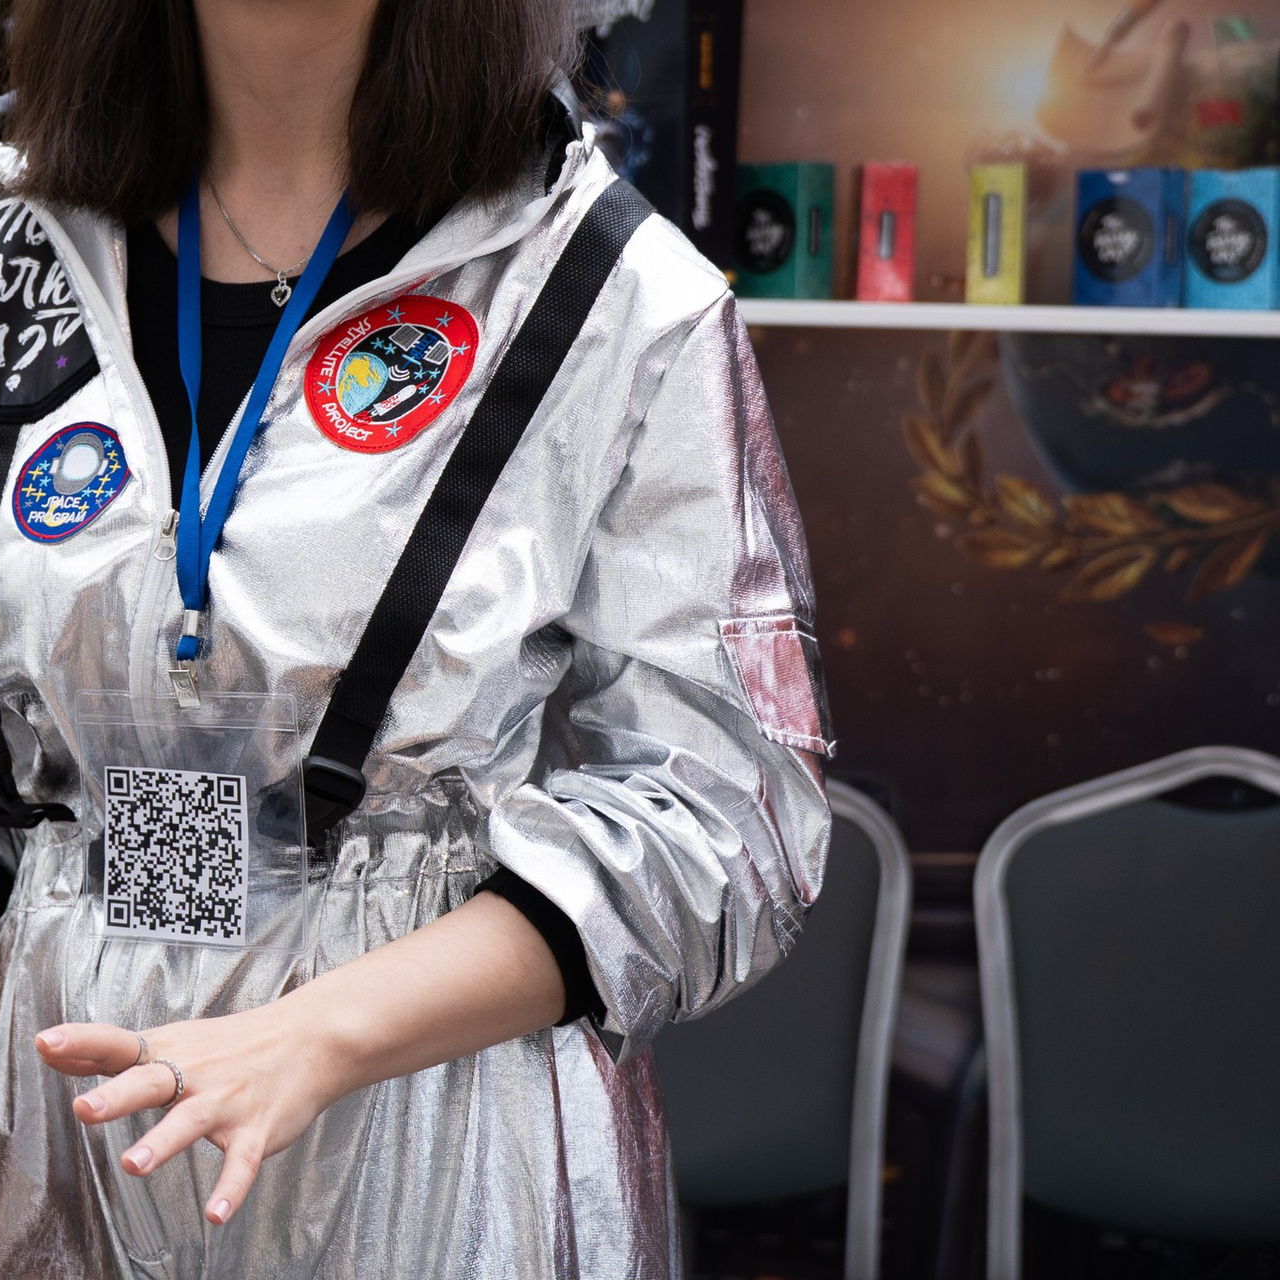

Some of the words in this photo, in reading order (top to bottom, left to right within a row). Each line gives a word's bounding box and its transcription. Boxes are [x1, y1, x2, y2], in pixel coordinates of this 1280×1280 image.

[321, 317, 372, 378] SATELLITE
[322, 402, 373, 442] PROJECT
[41, 495, 82, 510] SPACE
[27, 511, 88, 524] PROGRAM
